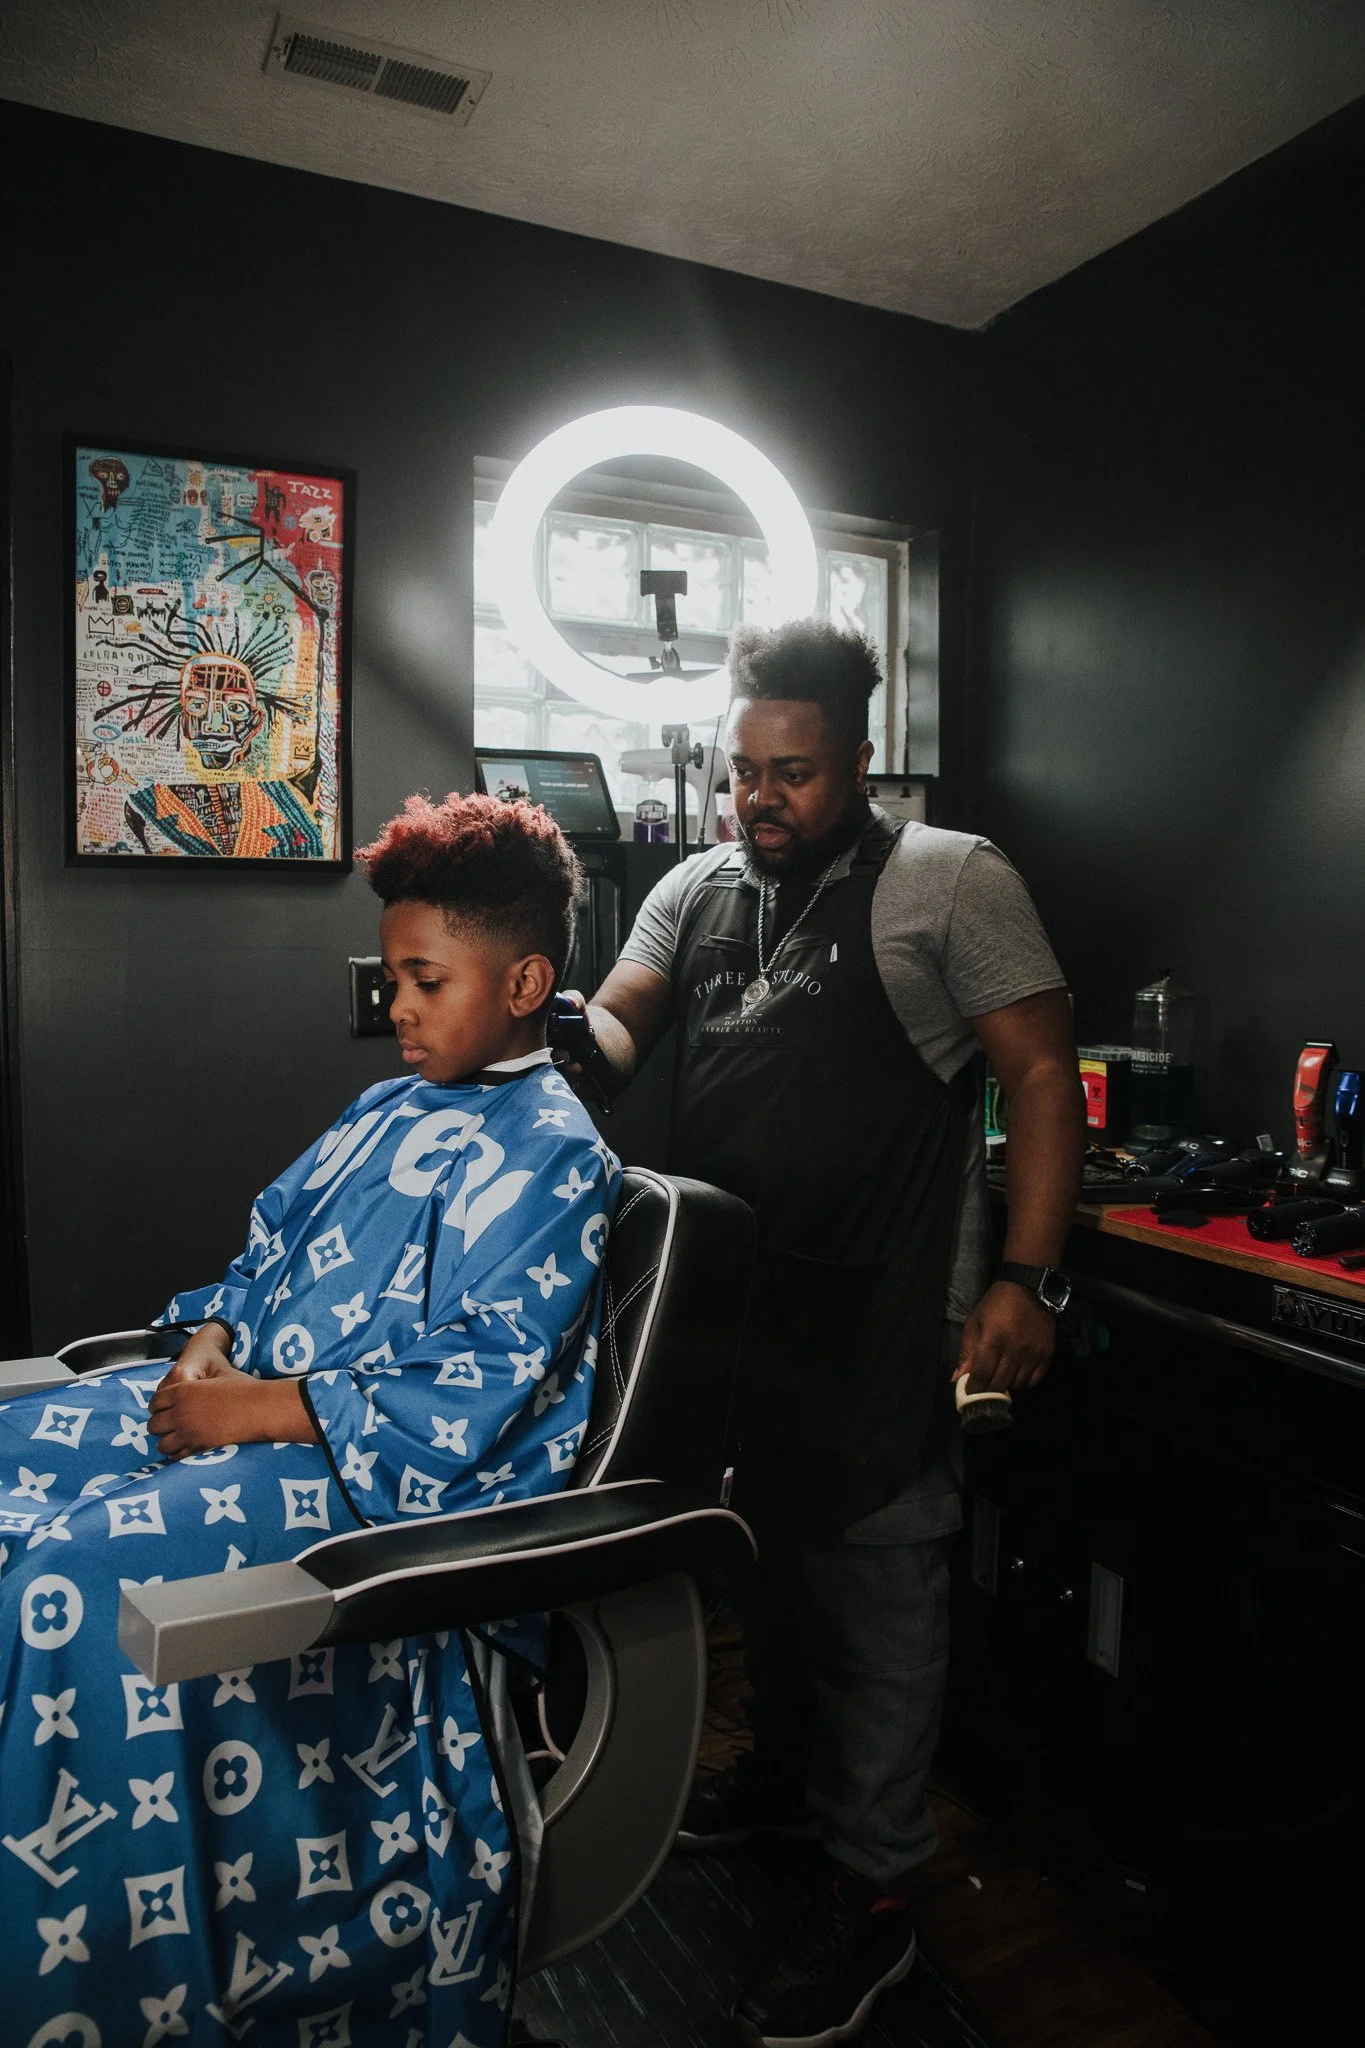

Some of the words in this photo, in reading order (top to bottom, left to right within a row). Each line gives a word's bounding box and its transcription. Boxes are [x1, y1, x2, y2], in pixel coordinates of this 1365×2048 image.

[287, 480, 333, 500] JAZZ
[122, 736, 146, 744] IDEAL
[693, 971, 746, 999] THREE
[771, 969, 822, 996] STUDIO
[745, 1026, 782, 1034] BEAUTY
